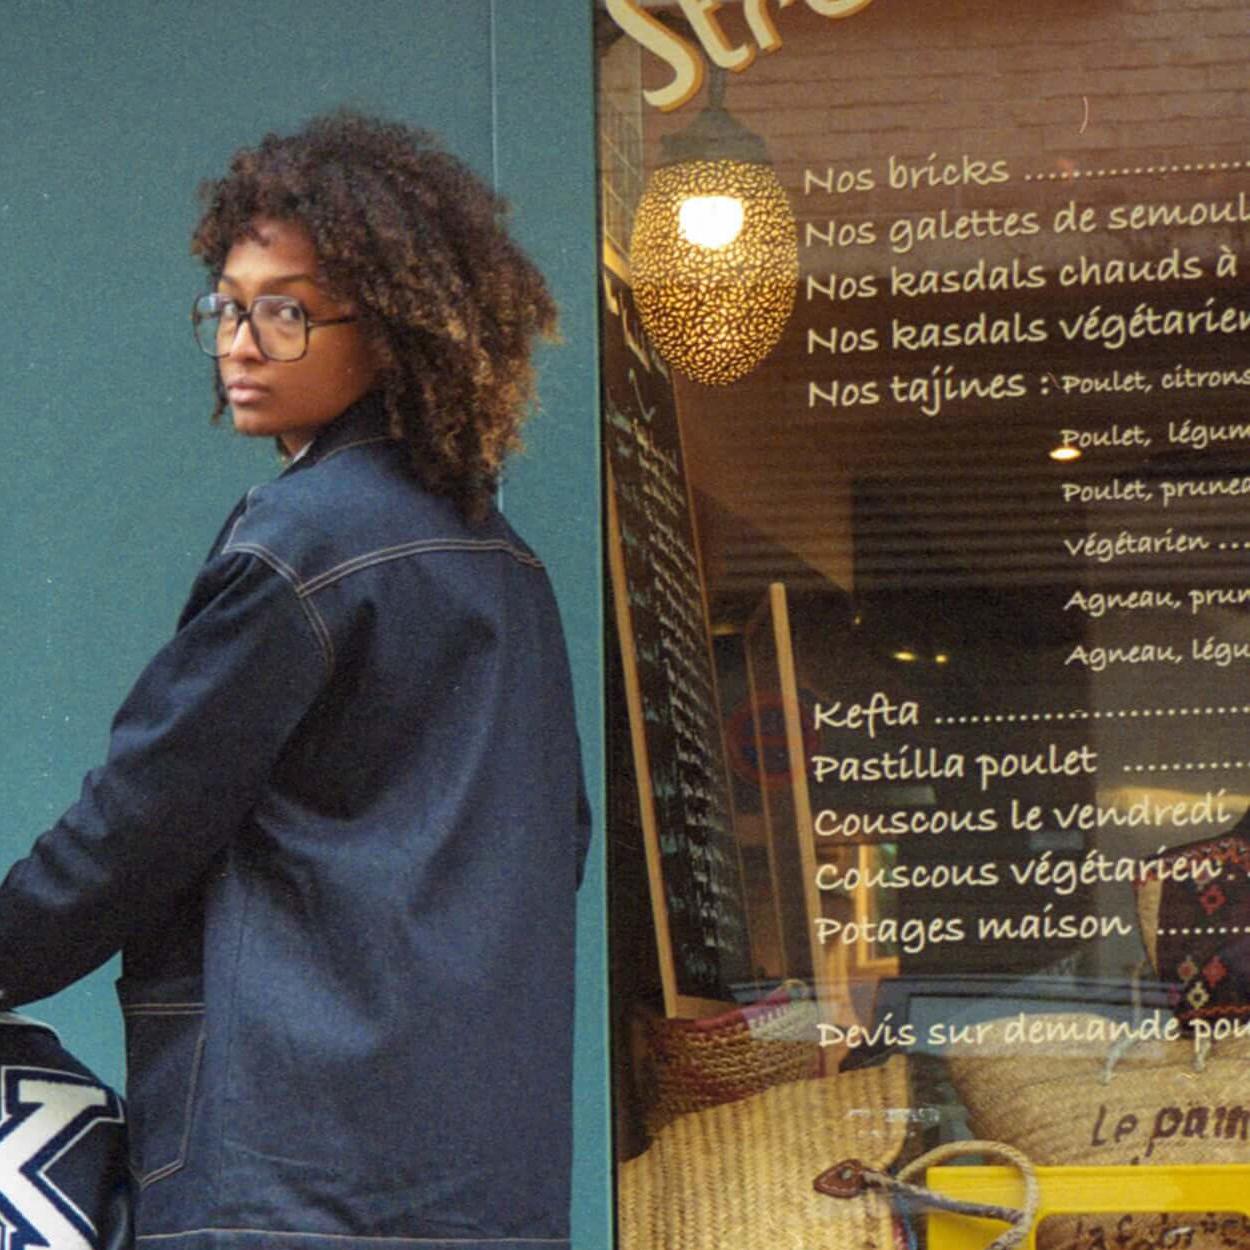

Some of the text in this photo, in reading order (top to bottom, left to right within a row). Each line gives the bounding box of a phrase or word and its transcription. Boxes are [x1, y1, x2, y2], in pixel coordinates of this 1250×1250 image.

[804, 153, 1010, 194] Nos bricks
[805, 220, 878, 247] Nos
[889, 209, 1041, 253] galettes
[1053, 201, 1096, 233] de
[806, 244, 1238, 300] Nos kasdals chauds à
[807, 326, 880, 354] Nos
[892, 313, 1049, 350] kasdals
[808, 379, 881, 408] Nos
[890, 365, 1028, 416] tajines
[1062, 370, 1153, 394] Poulet,
[1161, 364, 1250, 389] citrons
[1061, 424, 1152, 447] Poulet,
[1061, 479, 1153, 502] Poulet,
[1063, 590, 1182, 617] Agneau,
[1064, 645, 1183, 672] Agneau,
[813, 692, 919, 738] Kefta
[811, 744, 1097, 790] Pastilla poulet
[814, 788, 1231, 836] Couscous le vendredi
[815, 845, 1222, 895] Couscous végétarien
[815, 904, 1132, 953] Potages maison
[817, 1013, 916, 1048] Devis
[928, 1024, 993, 1047] sur
[1004, 1009, 1181, 1044] demande
